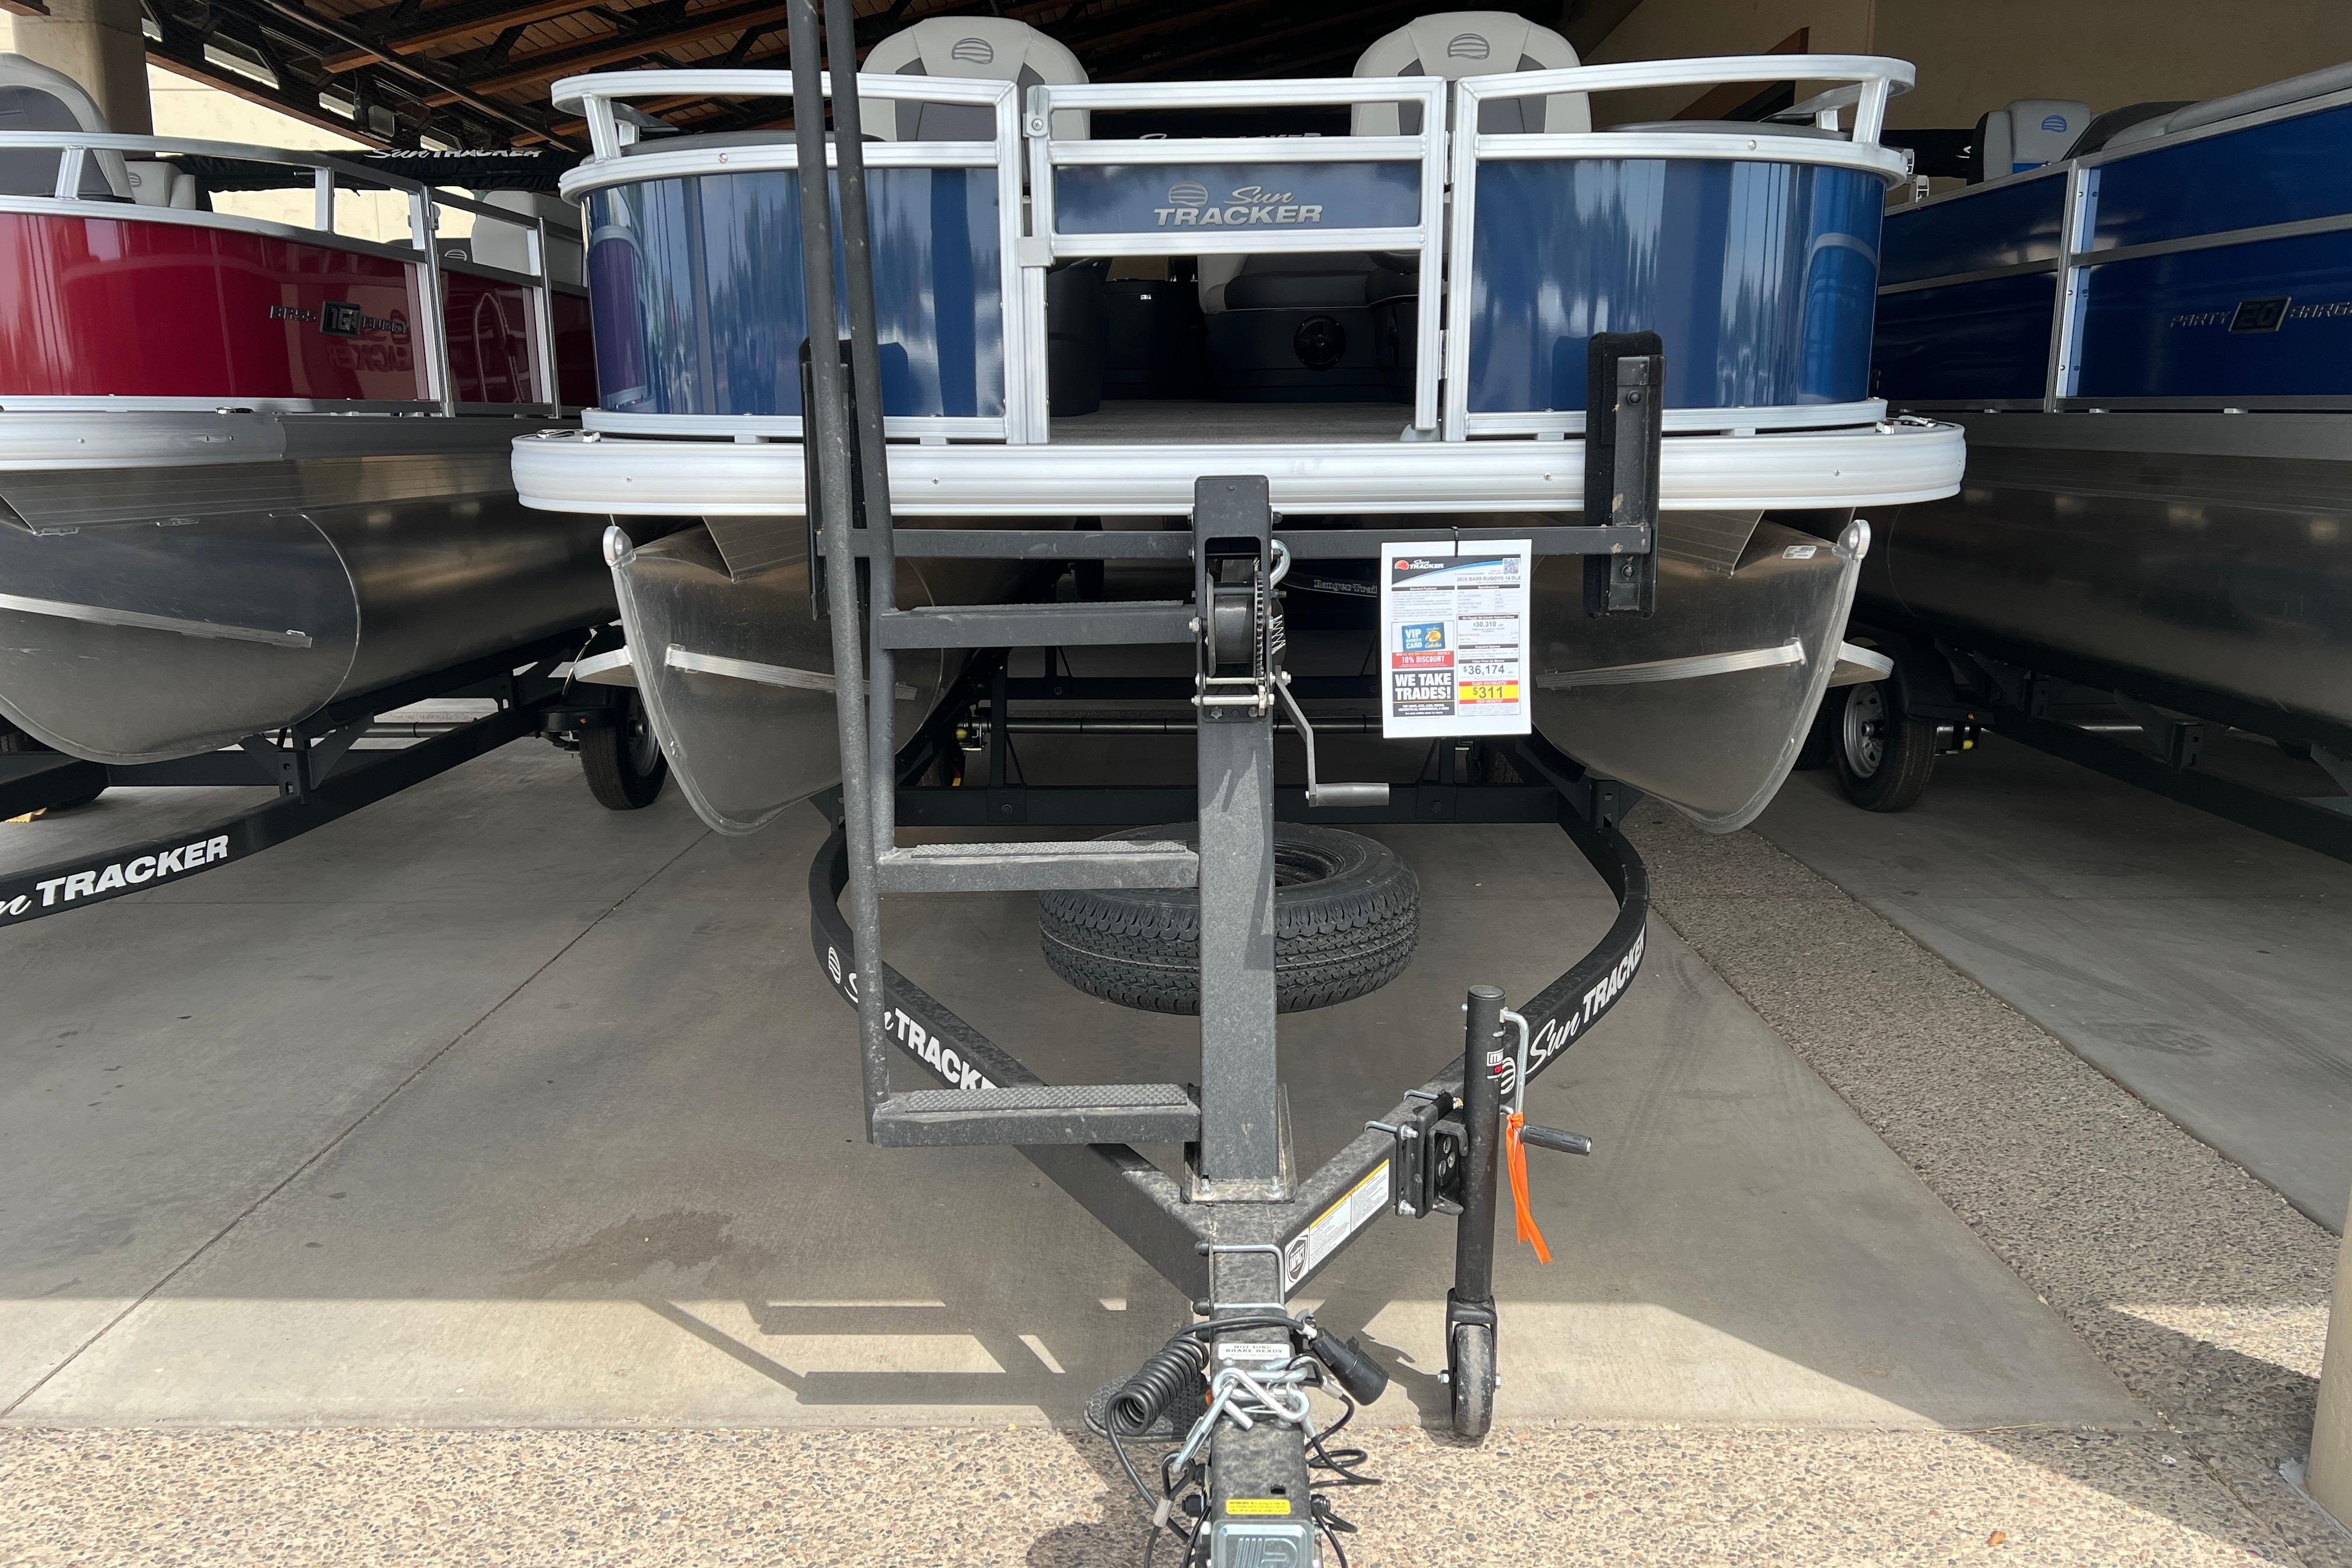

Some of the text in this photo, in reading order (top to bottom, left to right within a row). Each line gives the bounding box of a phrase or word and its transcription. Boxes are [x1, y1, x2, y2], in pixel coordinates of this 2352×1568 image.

[1223, 186, 1294, 205] Sun
[1154, 204, 1323, 226] TRACKER
[270, 305, 317, 322] BASS
[2170, 311, 2231, 328] PARTY
[2290, 301, 2352, 319] BARG
[1314, 579, 1352, 592] Ranger
[1405, 628, 1422, 639] VIP
[1463, 664, 1505, 676] $36,174
[1395, 673, 1451, 687] WE TAKE
[1395, 686, 1451, 701] TRADES!
[1473, 686, 1503, 698] $311
[36, 835, 229, 907] TRACKER
[895, 1007, 998, 1090] TRACK
[1525, 1011, 1581, 1073] Sun
[1289, 1246, 1305, 1272] IMPACT
